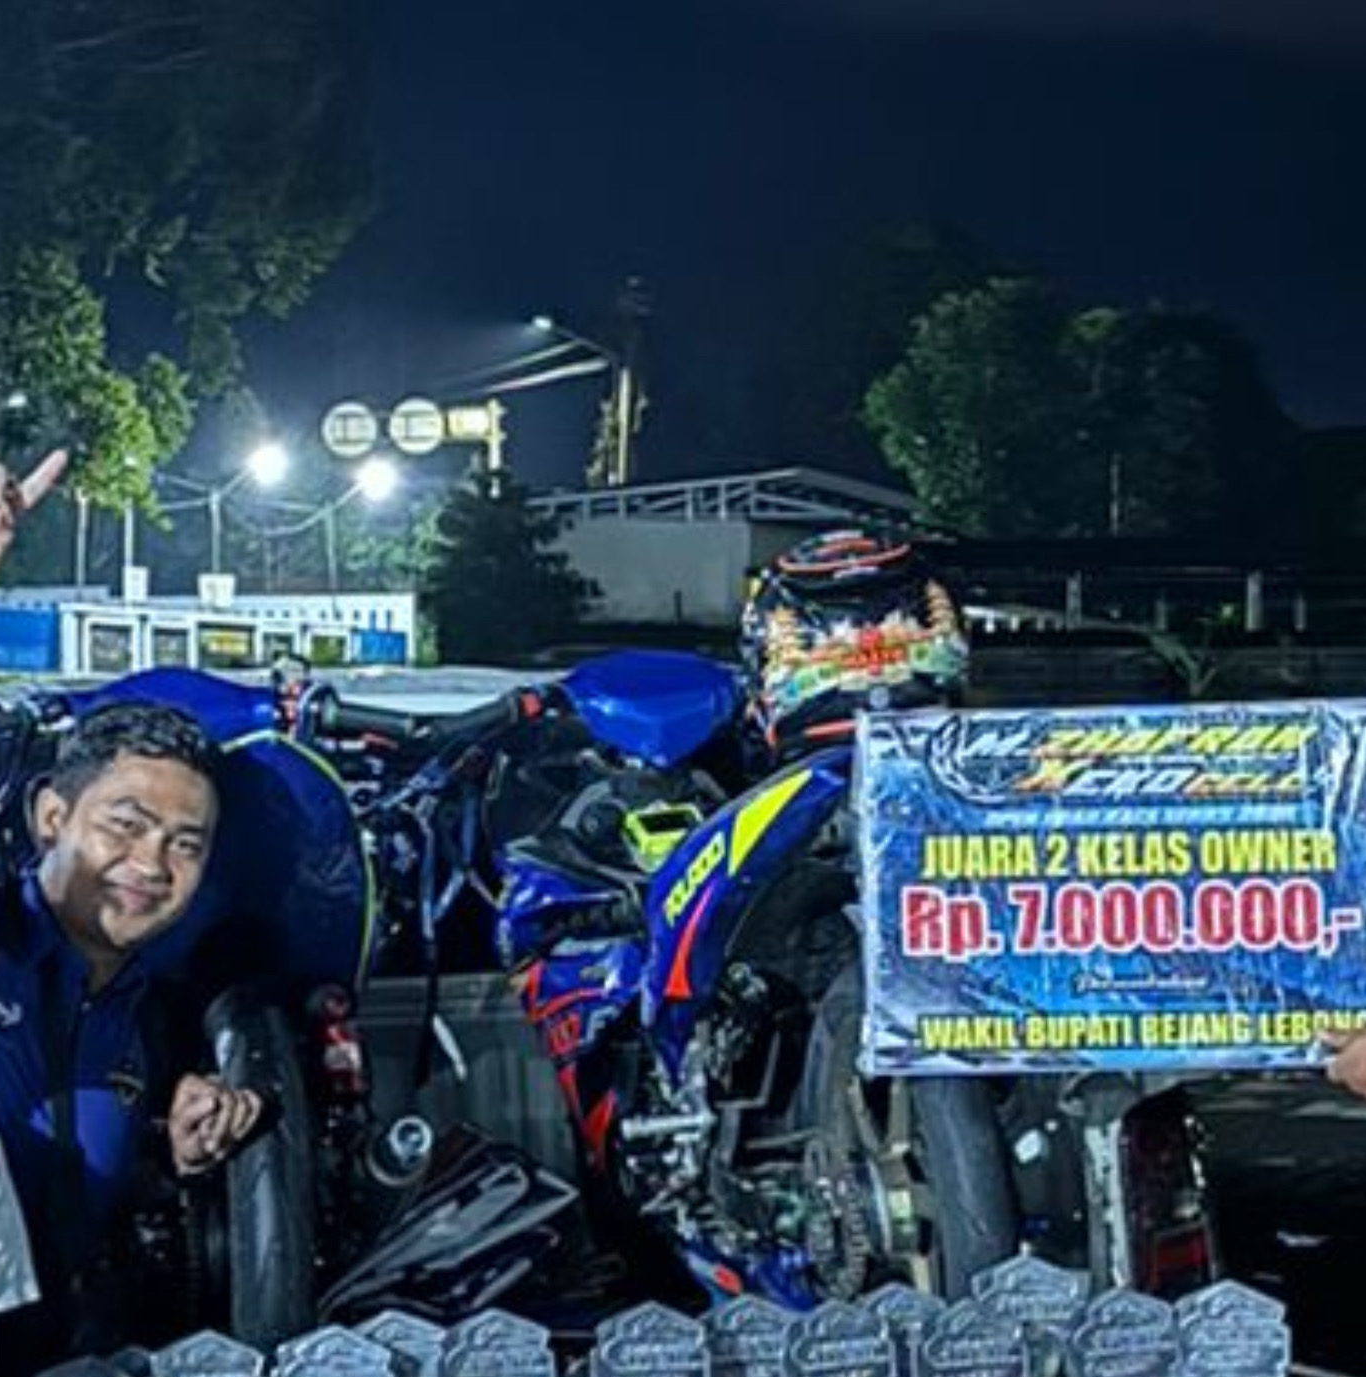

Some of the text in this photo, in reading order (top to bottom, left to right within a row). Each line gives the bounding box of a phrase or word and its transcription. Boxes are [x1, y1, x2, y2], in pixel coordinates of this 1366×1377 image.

[921, 829, 1337, 879] JUARA 2 KELAS OWNER
[901, 877, 1363, 964] Rp. 7.000.000,-
[921, 1014, 1020, 1050] WAKIL
[1024, 1012, 1134, 1049] BUPATI
